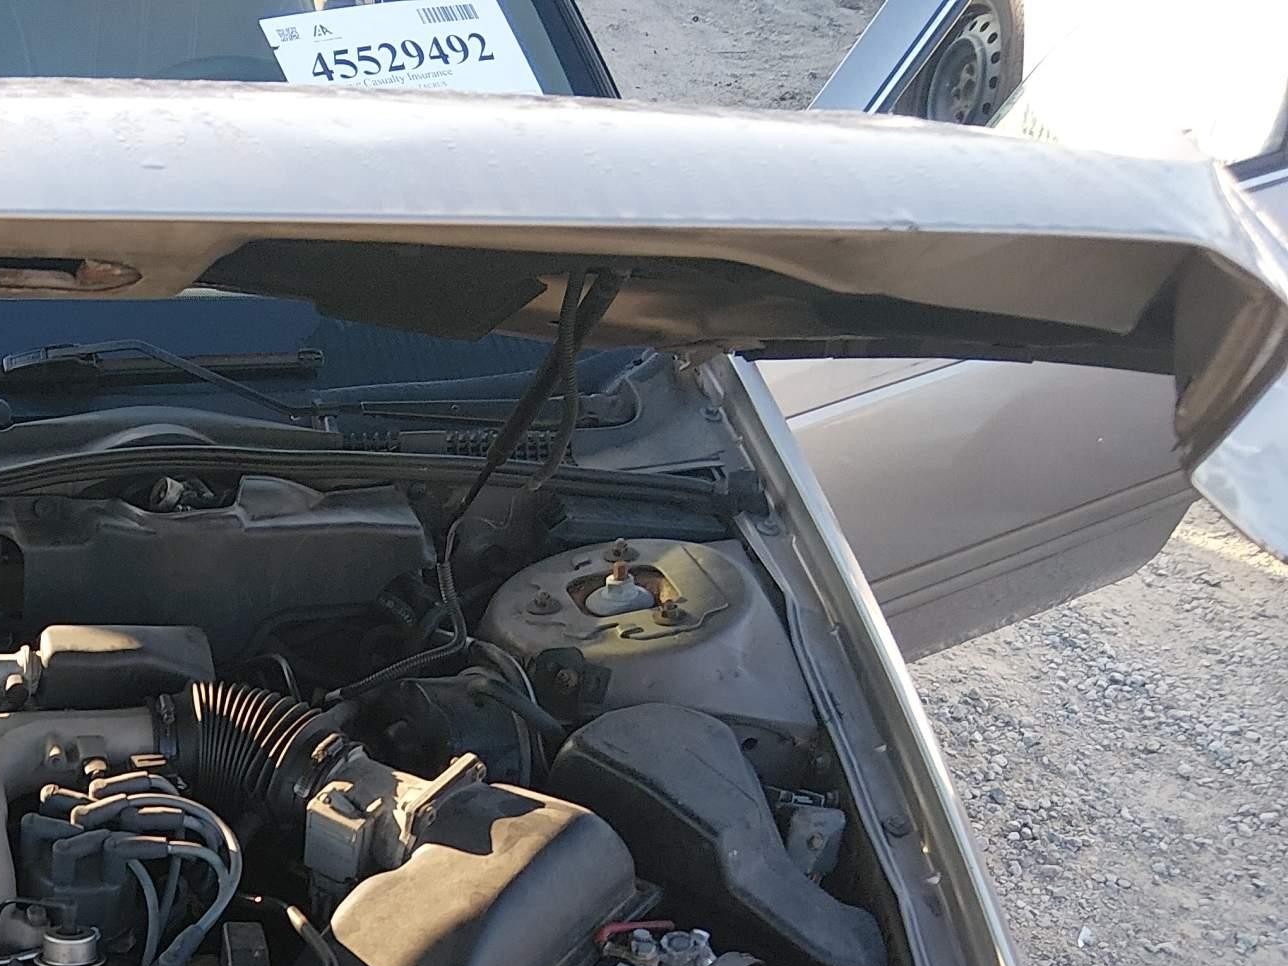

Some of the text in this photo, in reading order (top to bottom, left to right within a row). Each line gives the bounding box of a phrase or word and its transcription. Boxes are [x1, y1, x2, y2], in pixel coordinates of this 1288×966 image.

[312, 32, 495, 82] 45529492
[363, 74, 405, 88] Casualty
[406, 69, 454, 81] Insurance
